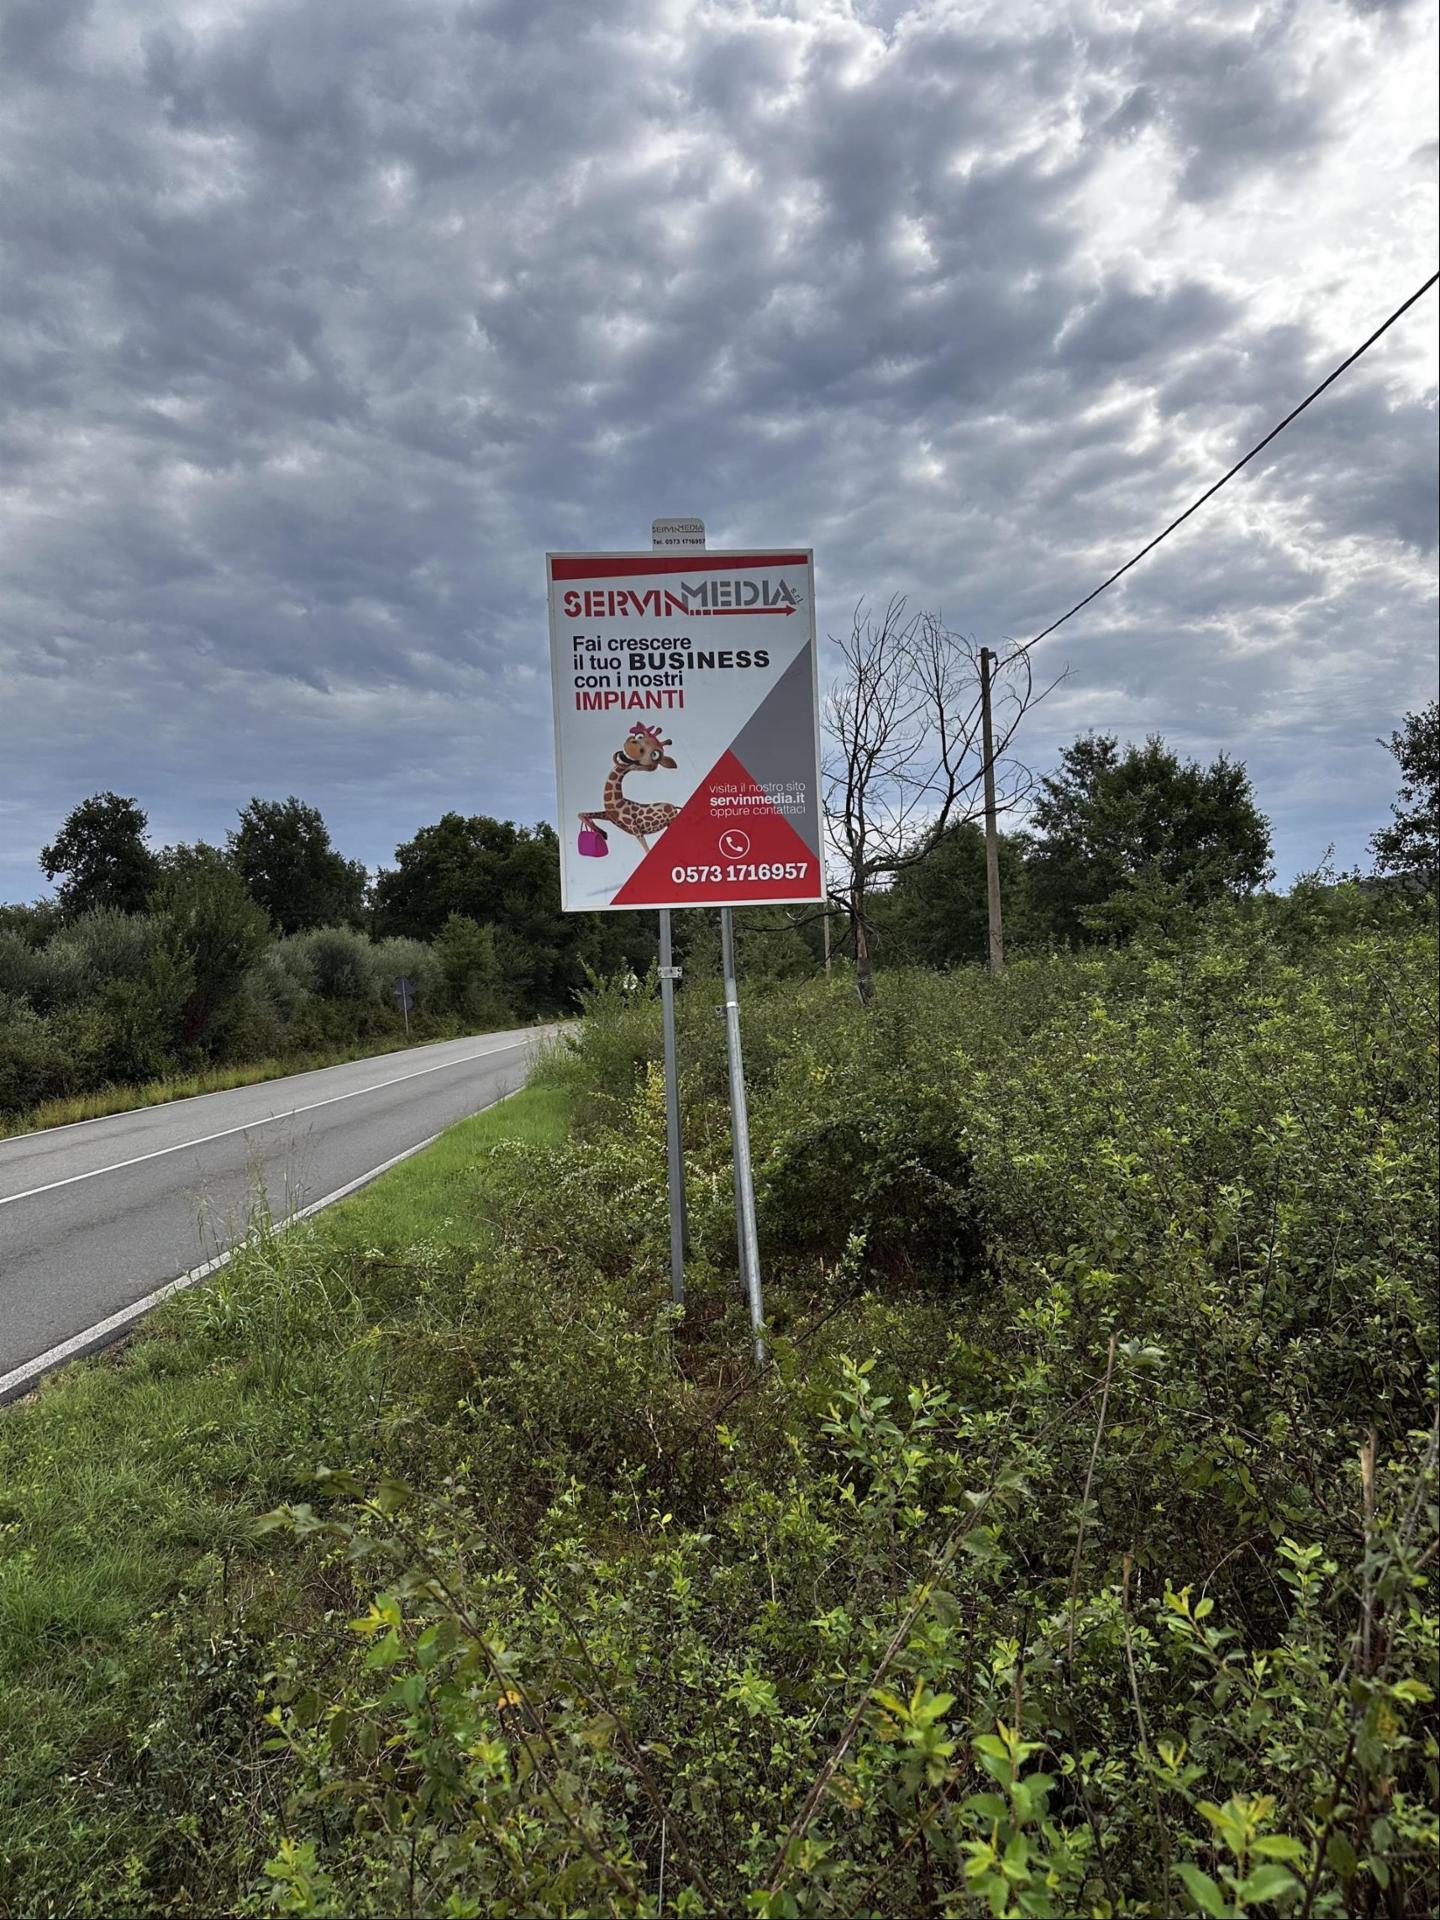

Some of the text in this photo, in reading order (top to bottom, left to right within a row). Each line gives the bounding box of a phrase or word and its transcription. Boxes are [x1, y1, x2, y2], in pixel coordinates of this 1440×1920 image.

[572, 635, 692, 652] Fai crescere
[573, 650, 770, 671] il tuo BUSINESS
[574, 671, 684, 688] con i nostri
[575, 689, 685, 711] IMPIANTI
[709, 781, 806, 794] visita il nostro sito
[709, 793, 806, 806] servinmedia.it
[710, 805, 806, 818] oppure contattaci
[671, 862, 808, 884] 0573 1716957
